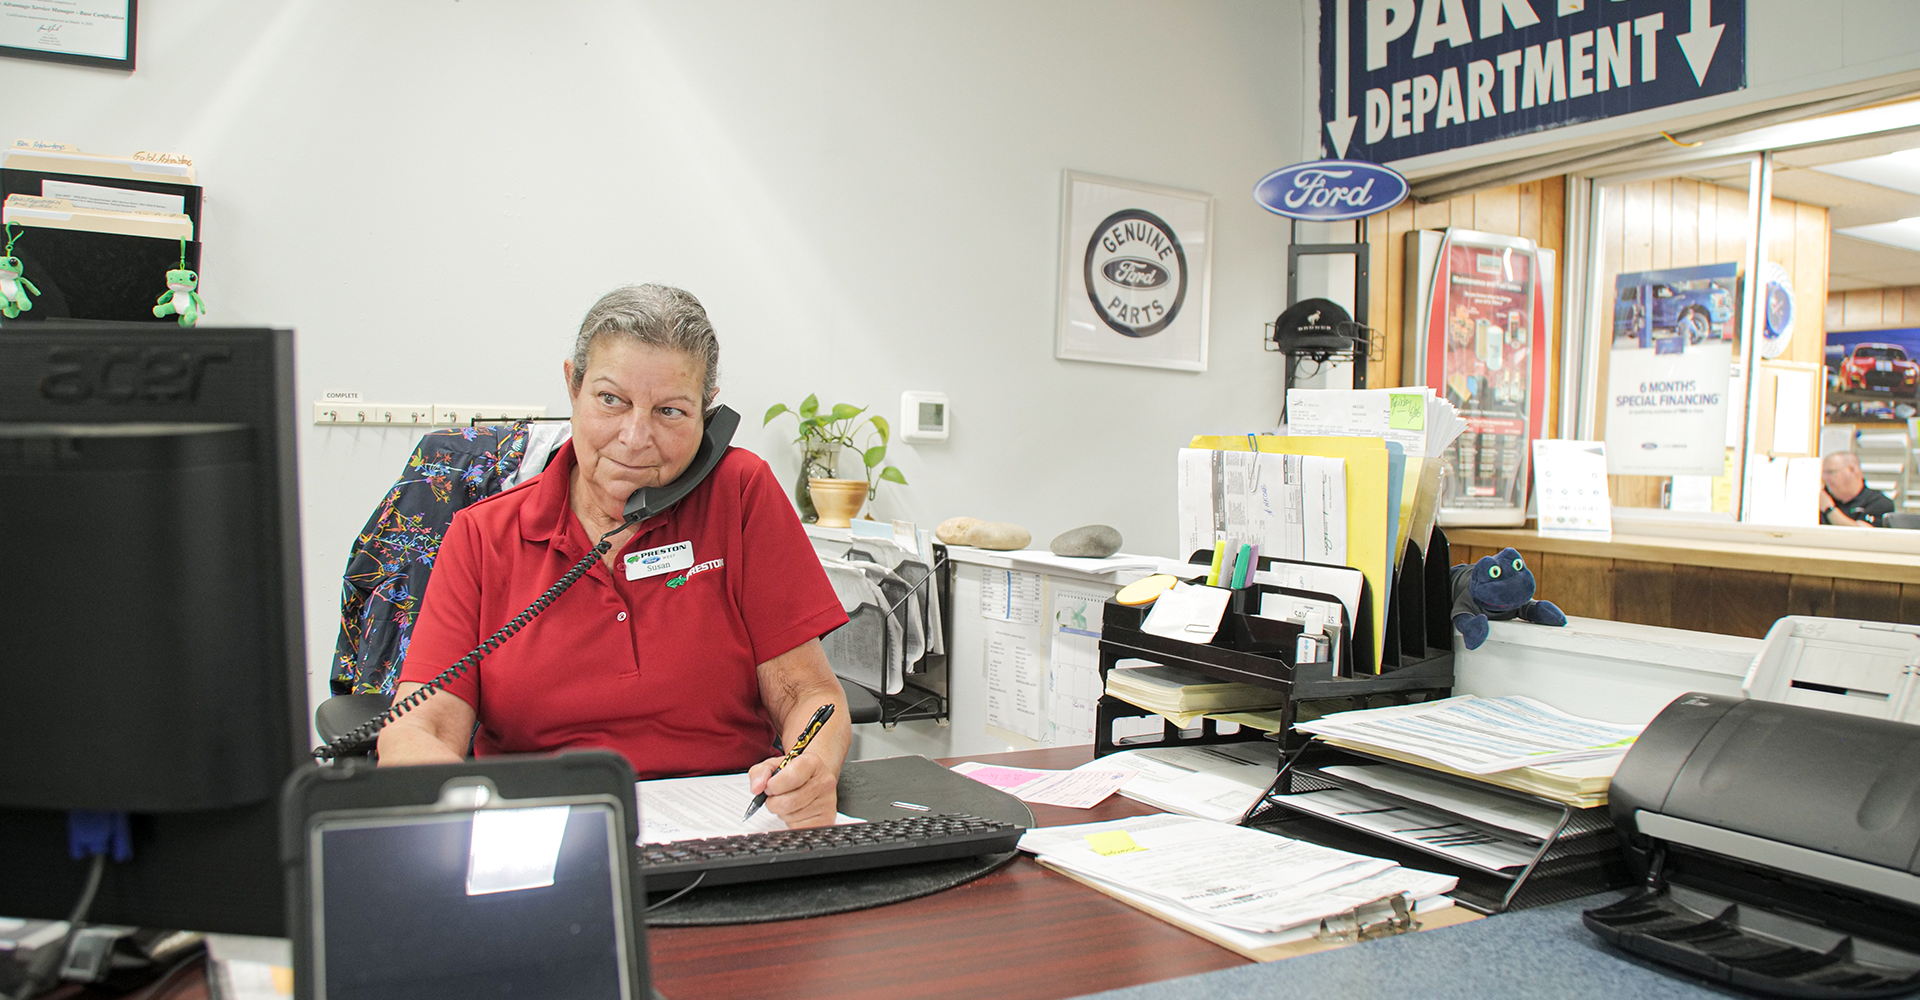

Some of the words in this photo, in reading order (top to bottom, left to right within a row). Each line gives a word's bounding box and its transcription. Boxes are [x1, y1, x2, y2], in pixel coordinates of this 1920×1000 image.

[93, 12, 125, 20] Certification
[1365, 12, 1664, 145] DEPARTMENT
[1284, 169, 1375, 209] Ford
[1102, 222, 1174, 261] GENUINE
[1114, 260, 1157, 285] Ford
[1108, 296, 1165, 324] PARTS
[38, 349, 234, 402] acer
[1640, 382, 1647, 393] 6
[1648, 380, 1696, 393] MONTHS
[1615, 395, 1658, 407] SPECIAL
[640, 544, 687, 559] PRESTON
[647, 562, 671, 572] Susan
